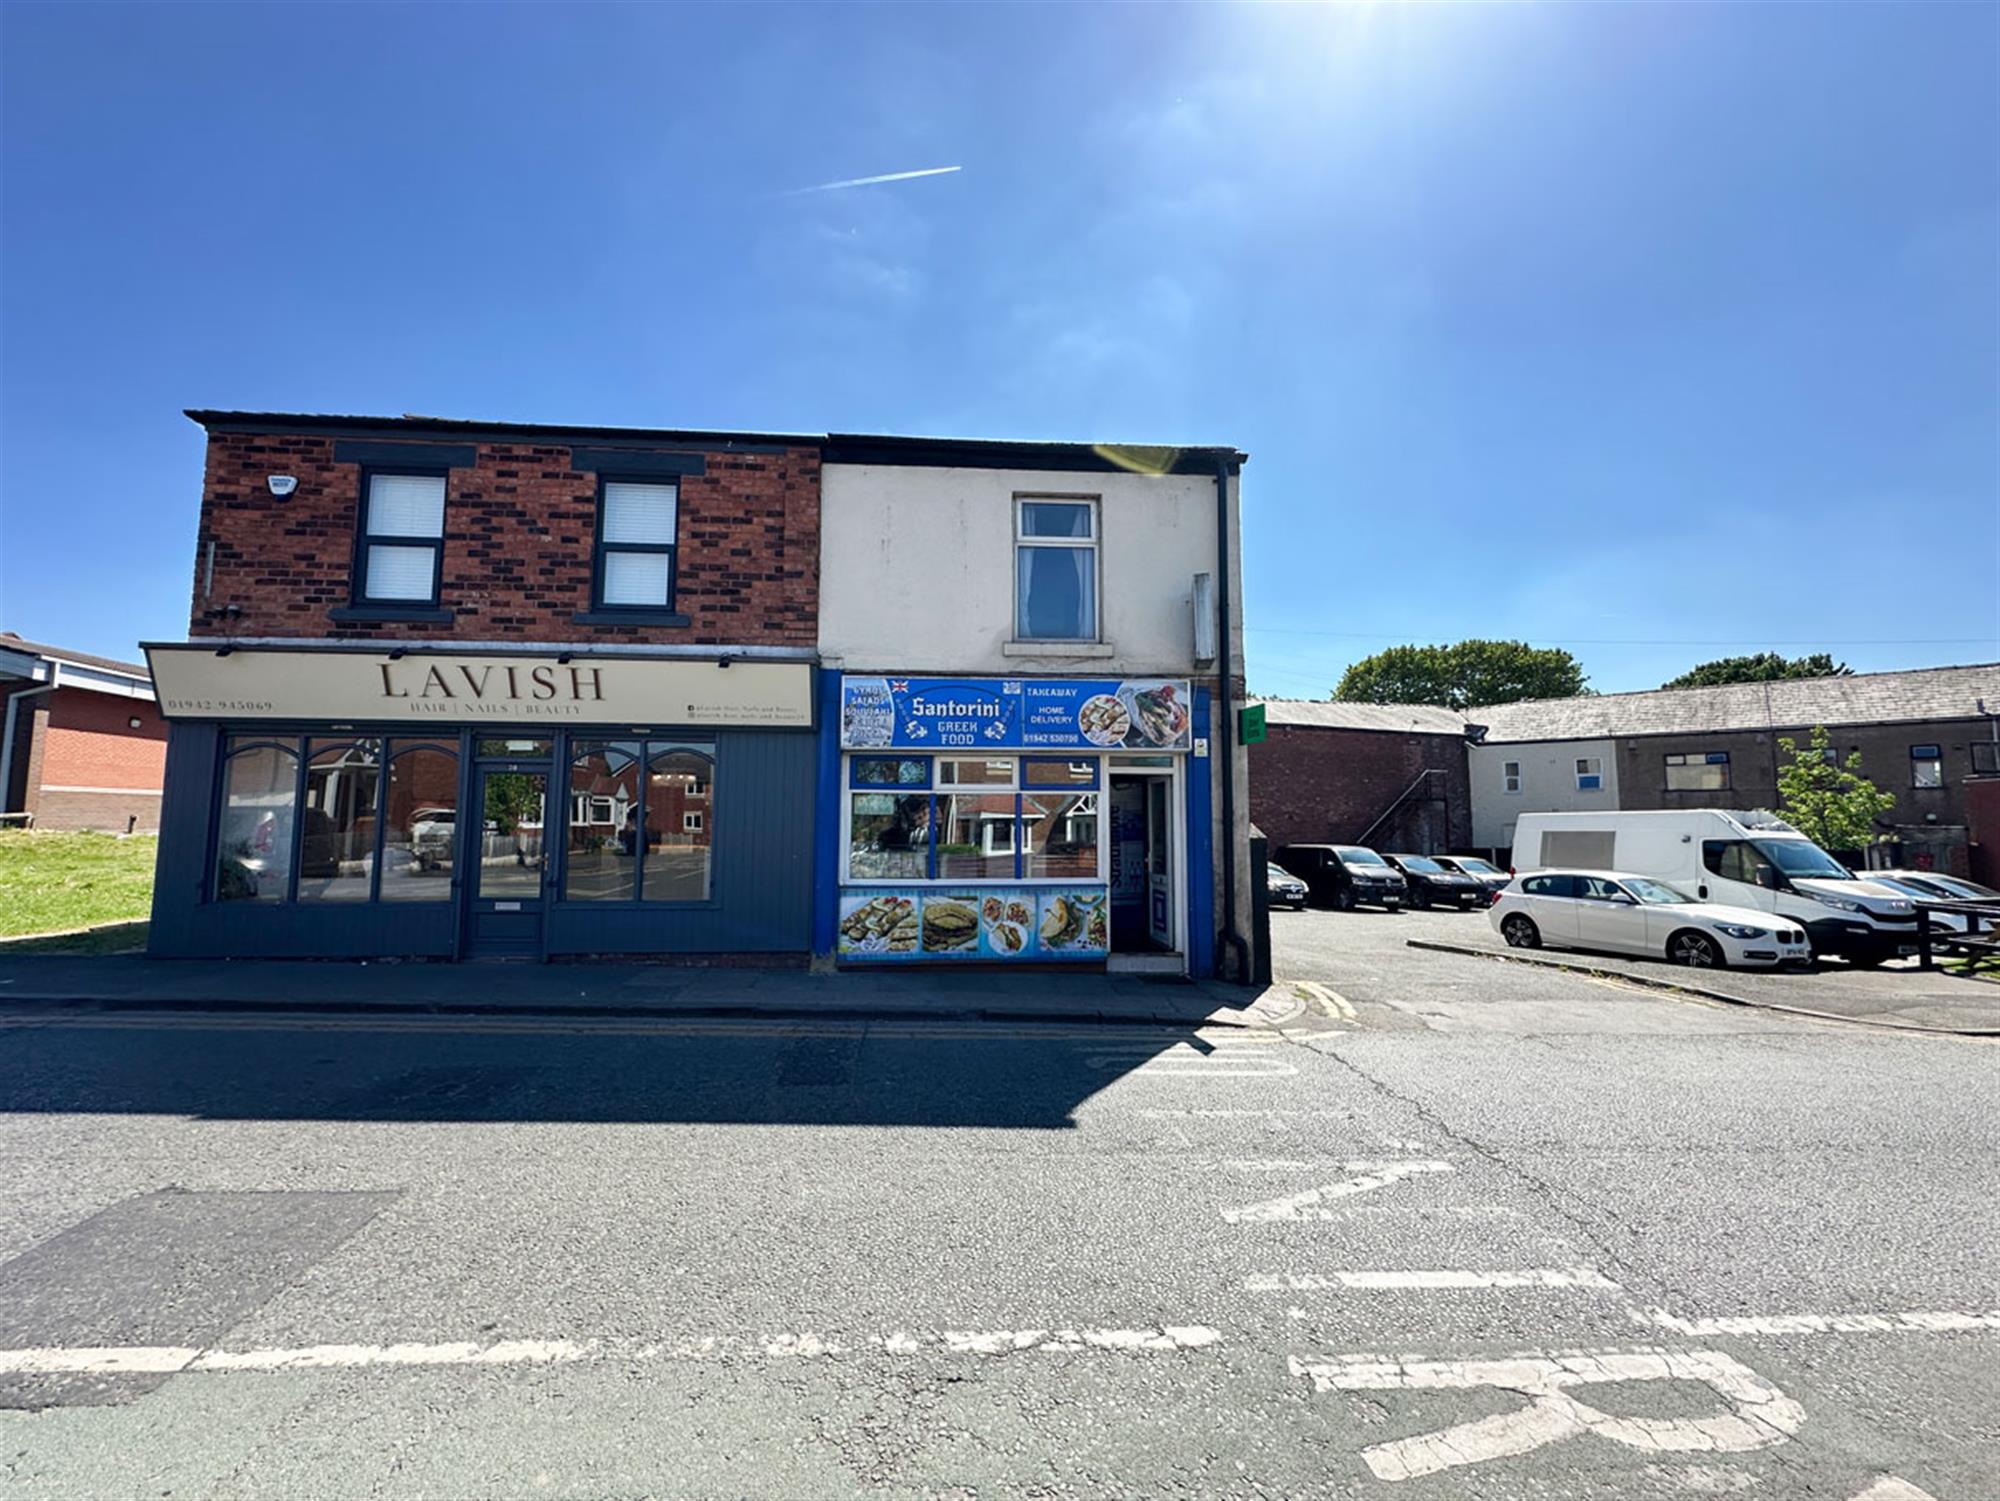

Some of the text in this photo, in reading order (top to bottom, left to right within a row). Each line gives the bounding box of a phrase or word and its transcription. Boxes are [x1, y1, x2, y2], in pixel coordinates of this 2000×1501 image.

[377, 663, 606, 701] LAVISH
[1027, 687, 1078, 696] TAKEAWAY
[410, 702, 581, 715] HAIR NAILS BEAUTY
[912, 697, 999, 717] Santorini
[1039, 706, 1064, 714] HOME
[1030, 715, 1073, 724] DELIVERY
[938, 721, 978, 732] GREEK
[941, 733, 975, 745] FOOD
